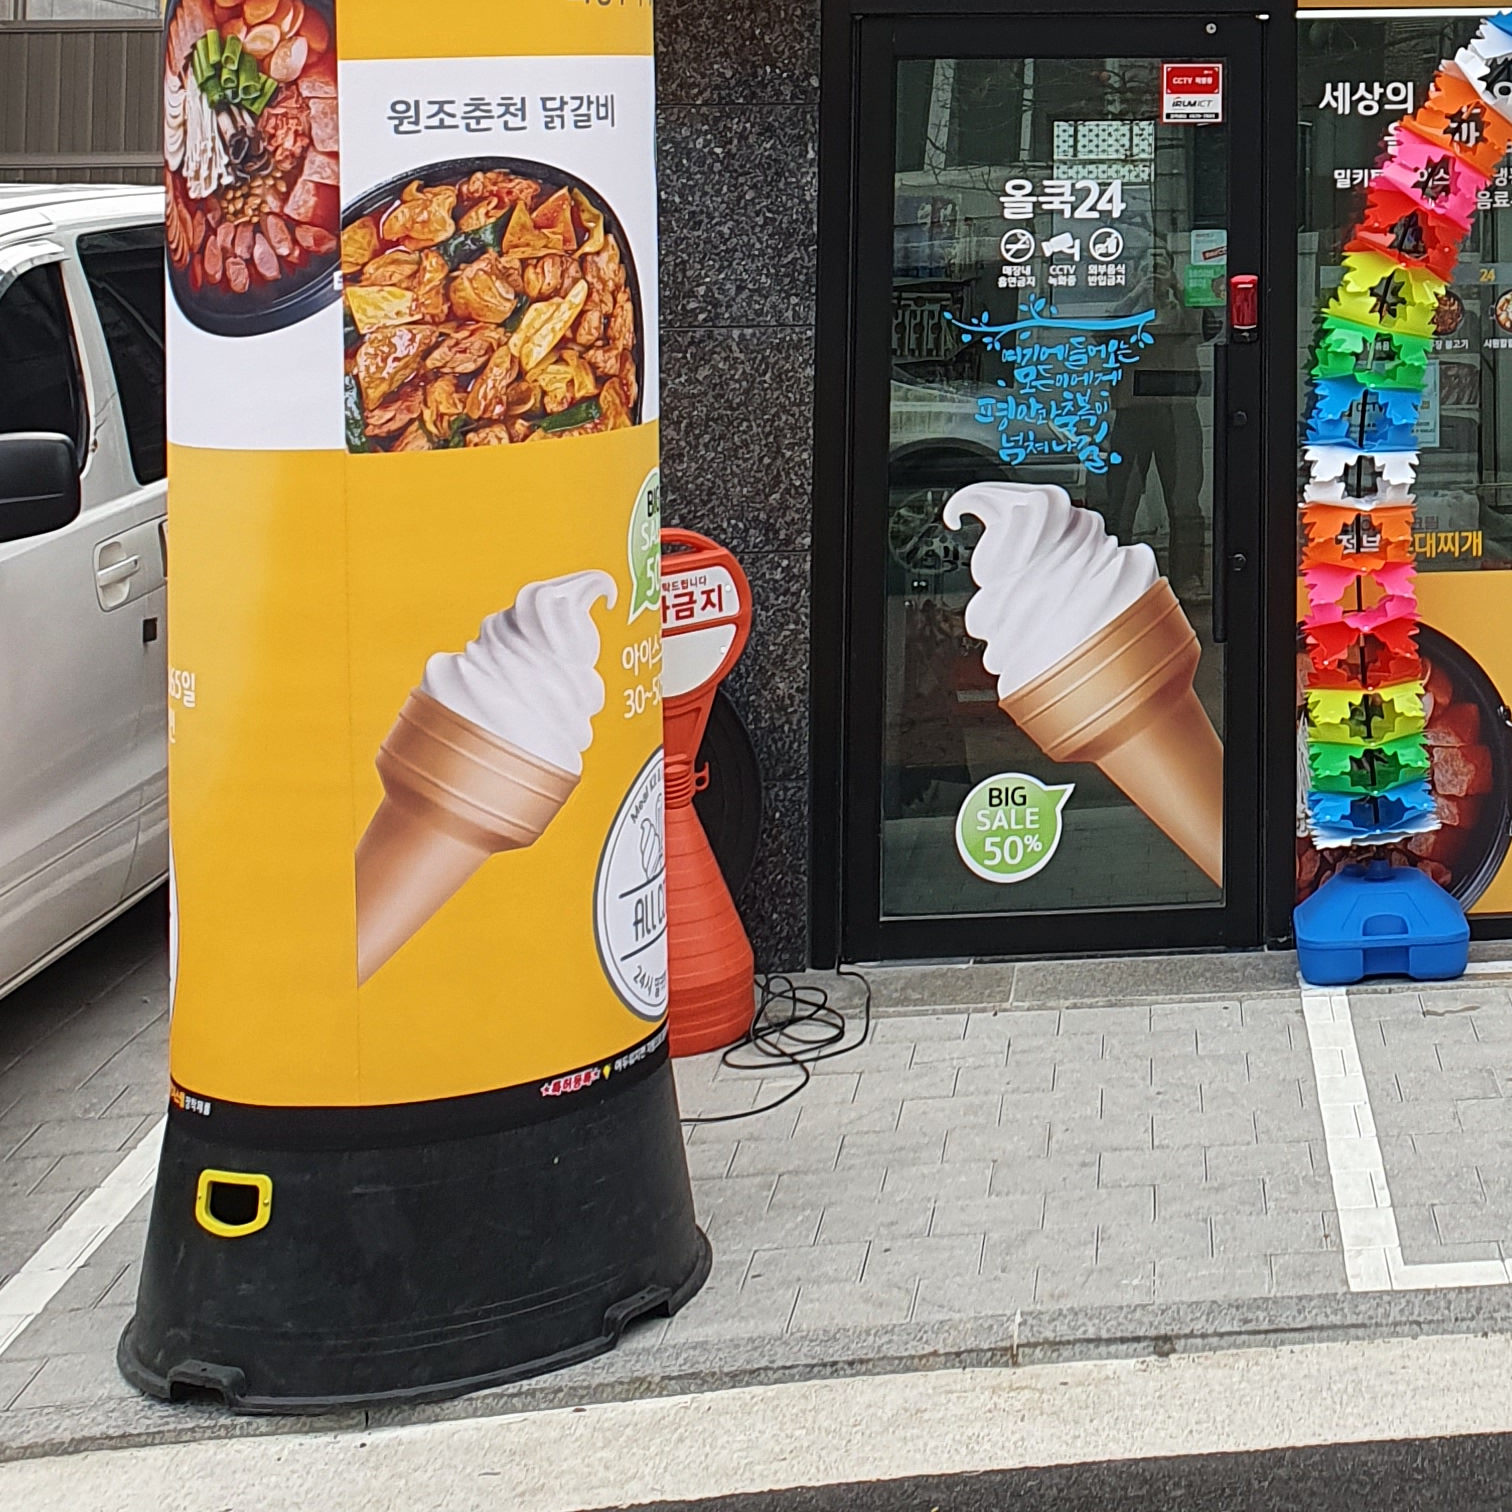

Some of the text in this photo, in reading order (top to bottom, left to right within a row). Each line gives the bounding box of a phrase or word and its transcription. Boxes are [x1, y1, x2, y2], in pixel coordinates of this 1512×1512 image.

[1172, 76, 1192, 84] CCTV
[1319, 81, 1414, 116] 세상의
[386, 94, 616, 135] 원조춘천 닭갈비
[1000, 179, 1126, 219] 올쿡24
[1002, 265, 1031, 276] 매장내
[1049, 265, 1076, 275] CCTV
[1088, 264, 1125, 275] 외부음식
[1479, 269, 1495, 282] 24
[998, 276, 1035, 288] 흡연금지
[1048, 275, 1077, 286] 녹화중
[1088, 275, 1125, 286] 반입금지
[1014, 365, 1054, 394] 모든
[1408, 531, 1482, 558] 대찌개
[987, 787, 1027, 807] BIG
[976, 808, 1040, 831] SALE
[983, 834, 1042, 866] 50%
